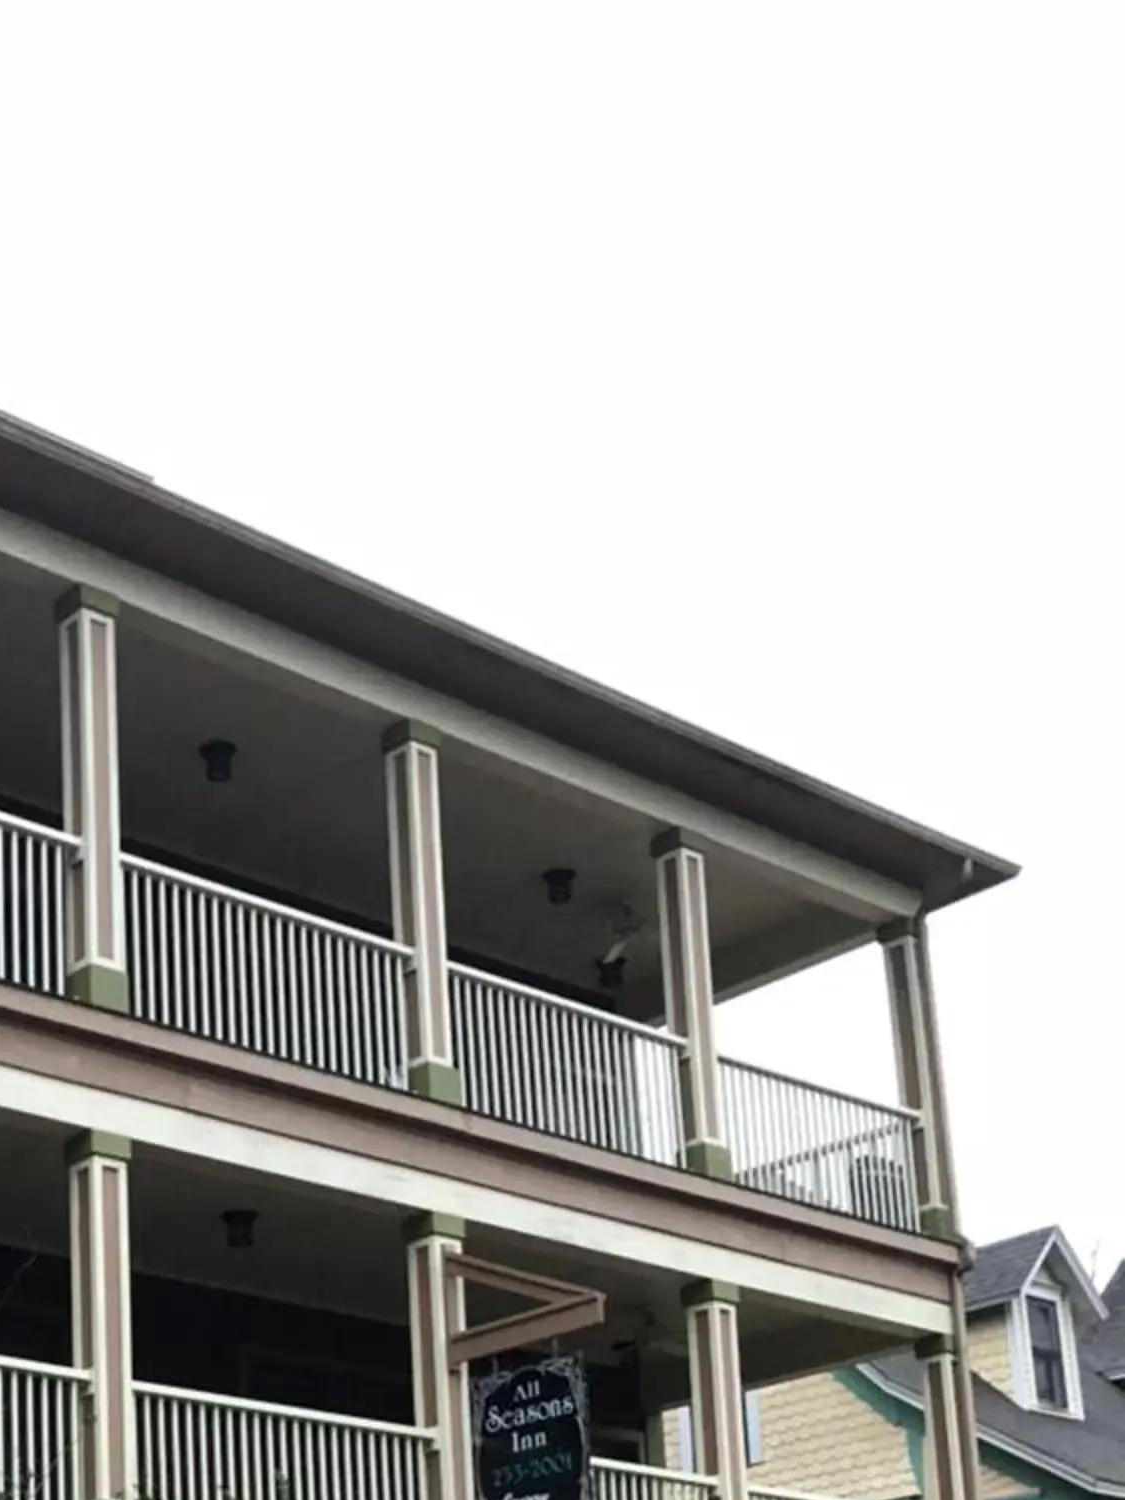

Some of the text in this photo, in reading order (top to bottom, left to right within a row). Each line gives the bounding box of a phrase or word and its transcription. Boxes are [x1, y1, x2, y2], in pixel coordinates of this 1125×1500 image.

[514, 1379, 540, 1401] All
[485, 1396, 573, 1433] Seasons
[511, 1431, 547, 1453] Inn
